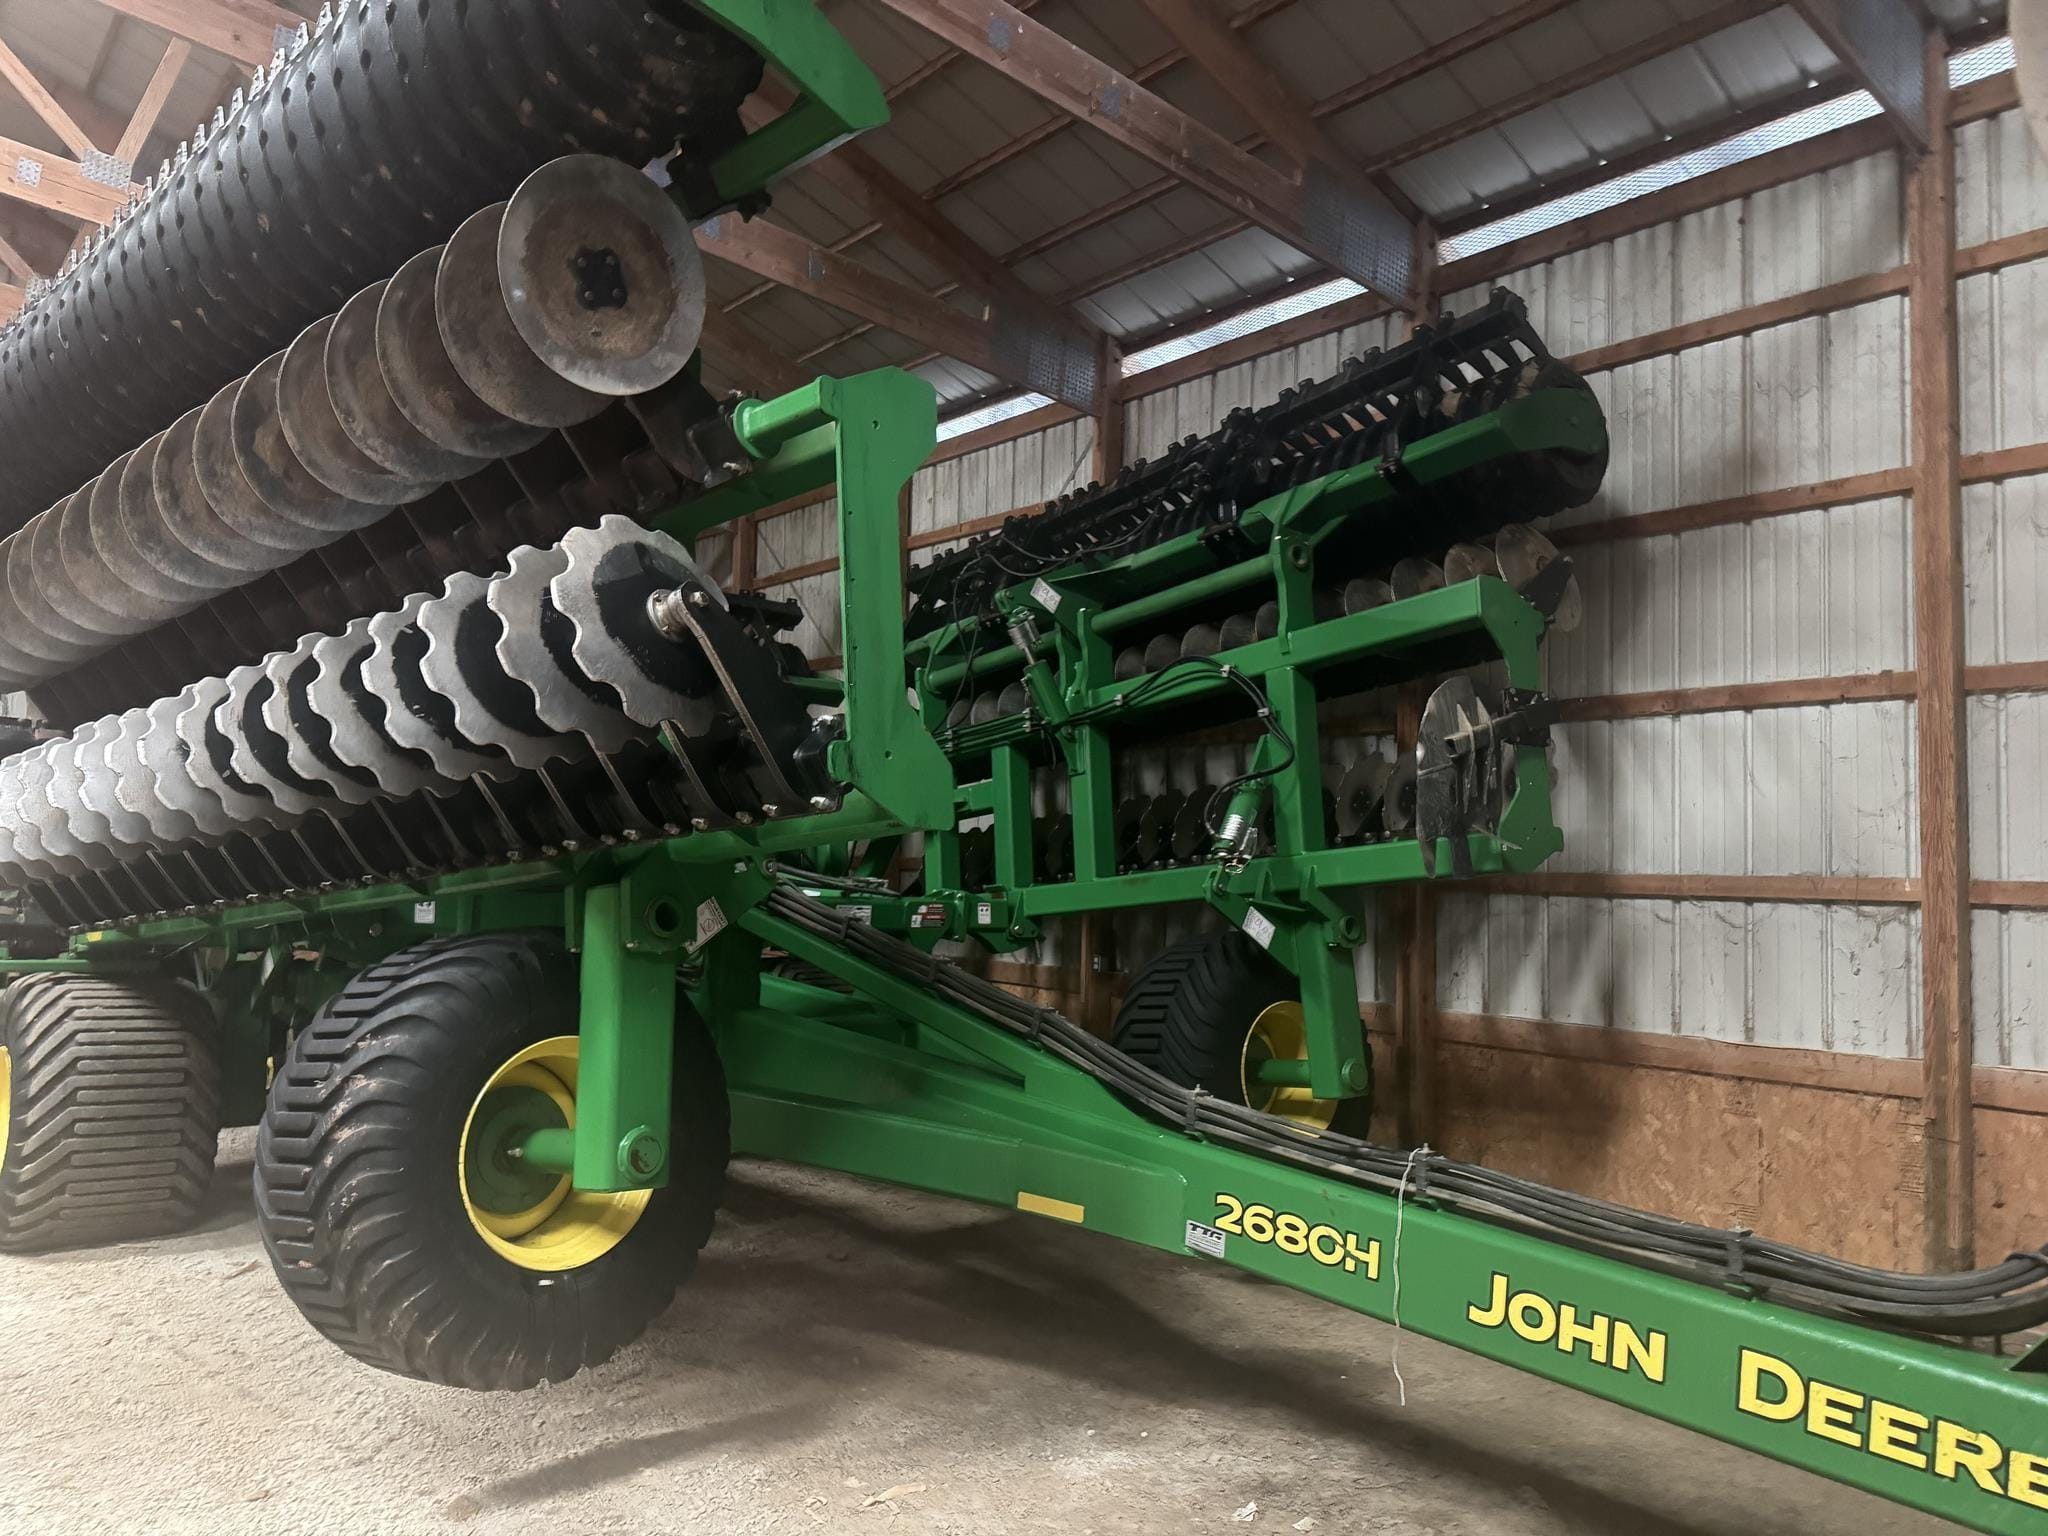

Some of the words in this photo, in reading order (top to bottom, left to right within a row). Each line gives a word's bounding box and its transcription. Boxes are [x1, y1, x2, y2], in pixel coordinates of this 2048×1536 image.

[1214, 1193, 1381, 1281] 2680H
[1467, 1272, 1668, 1384] JOHN
[1736, 1346, 2048, 1511] DEERE
